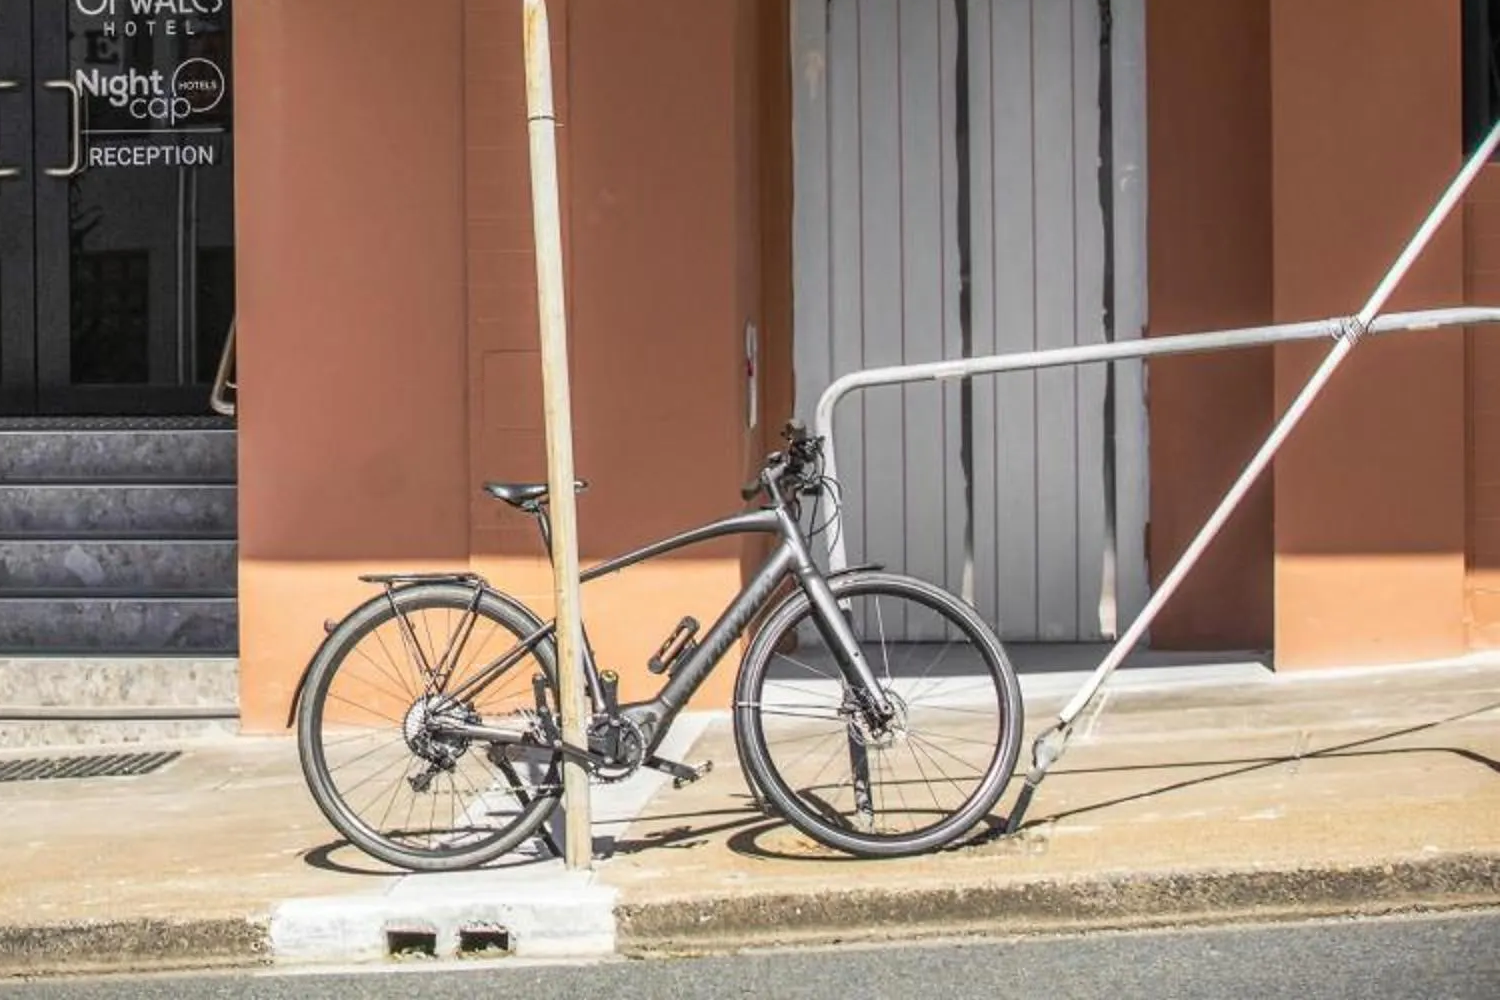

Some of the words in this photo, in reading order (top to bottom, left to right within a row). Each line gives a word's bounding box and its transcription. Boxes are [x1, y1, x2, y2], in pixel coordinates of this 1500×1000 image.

[103, 19, 196, 37] HOTEL
[75, 67, 165, 107] Night
[179, 80, 217, 91] HOTELS
[129, 97, 192, 126] cap
[89, 145, 214, 167] RECEPTION
